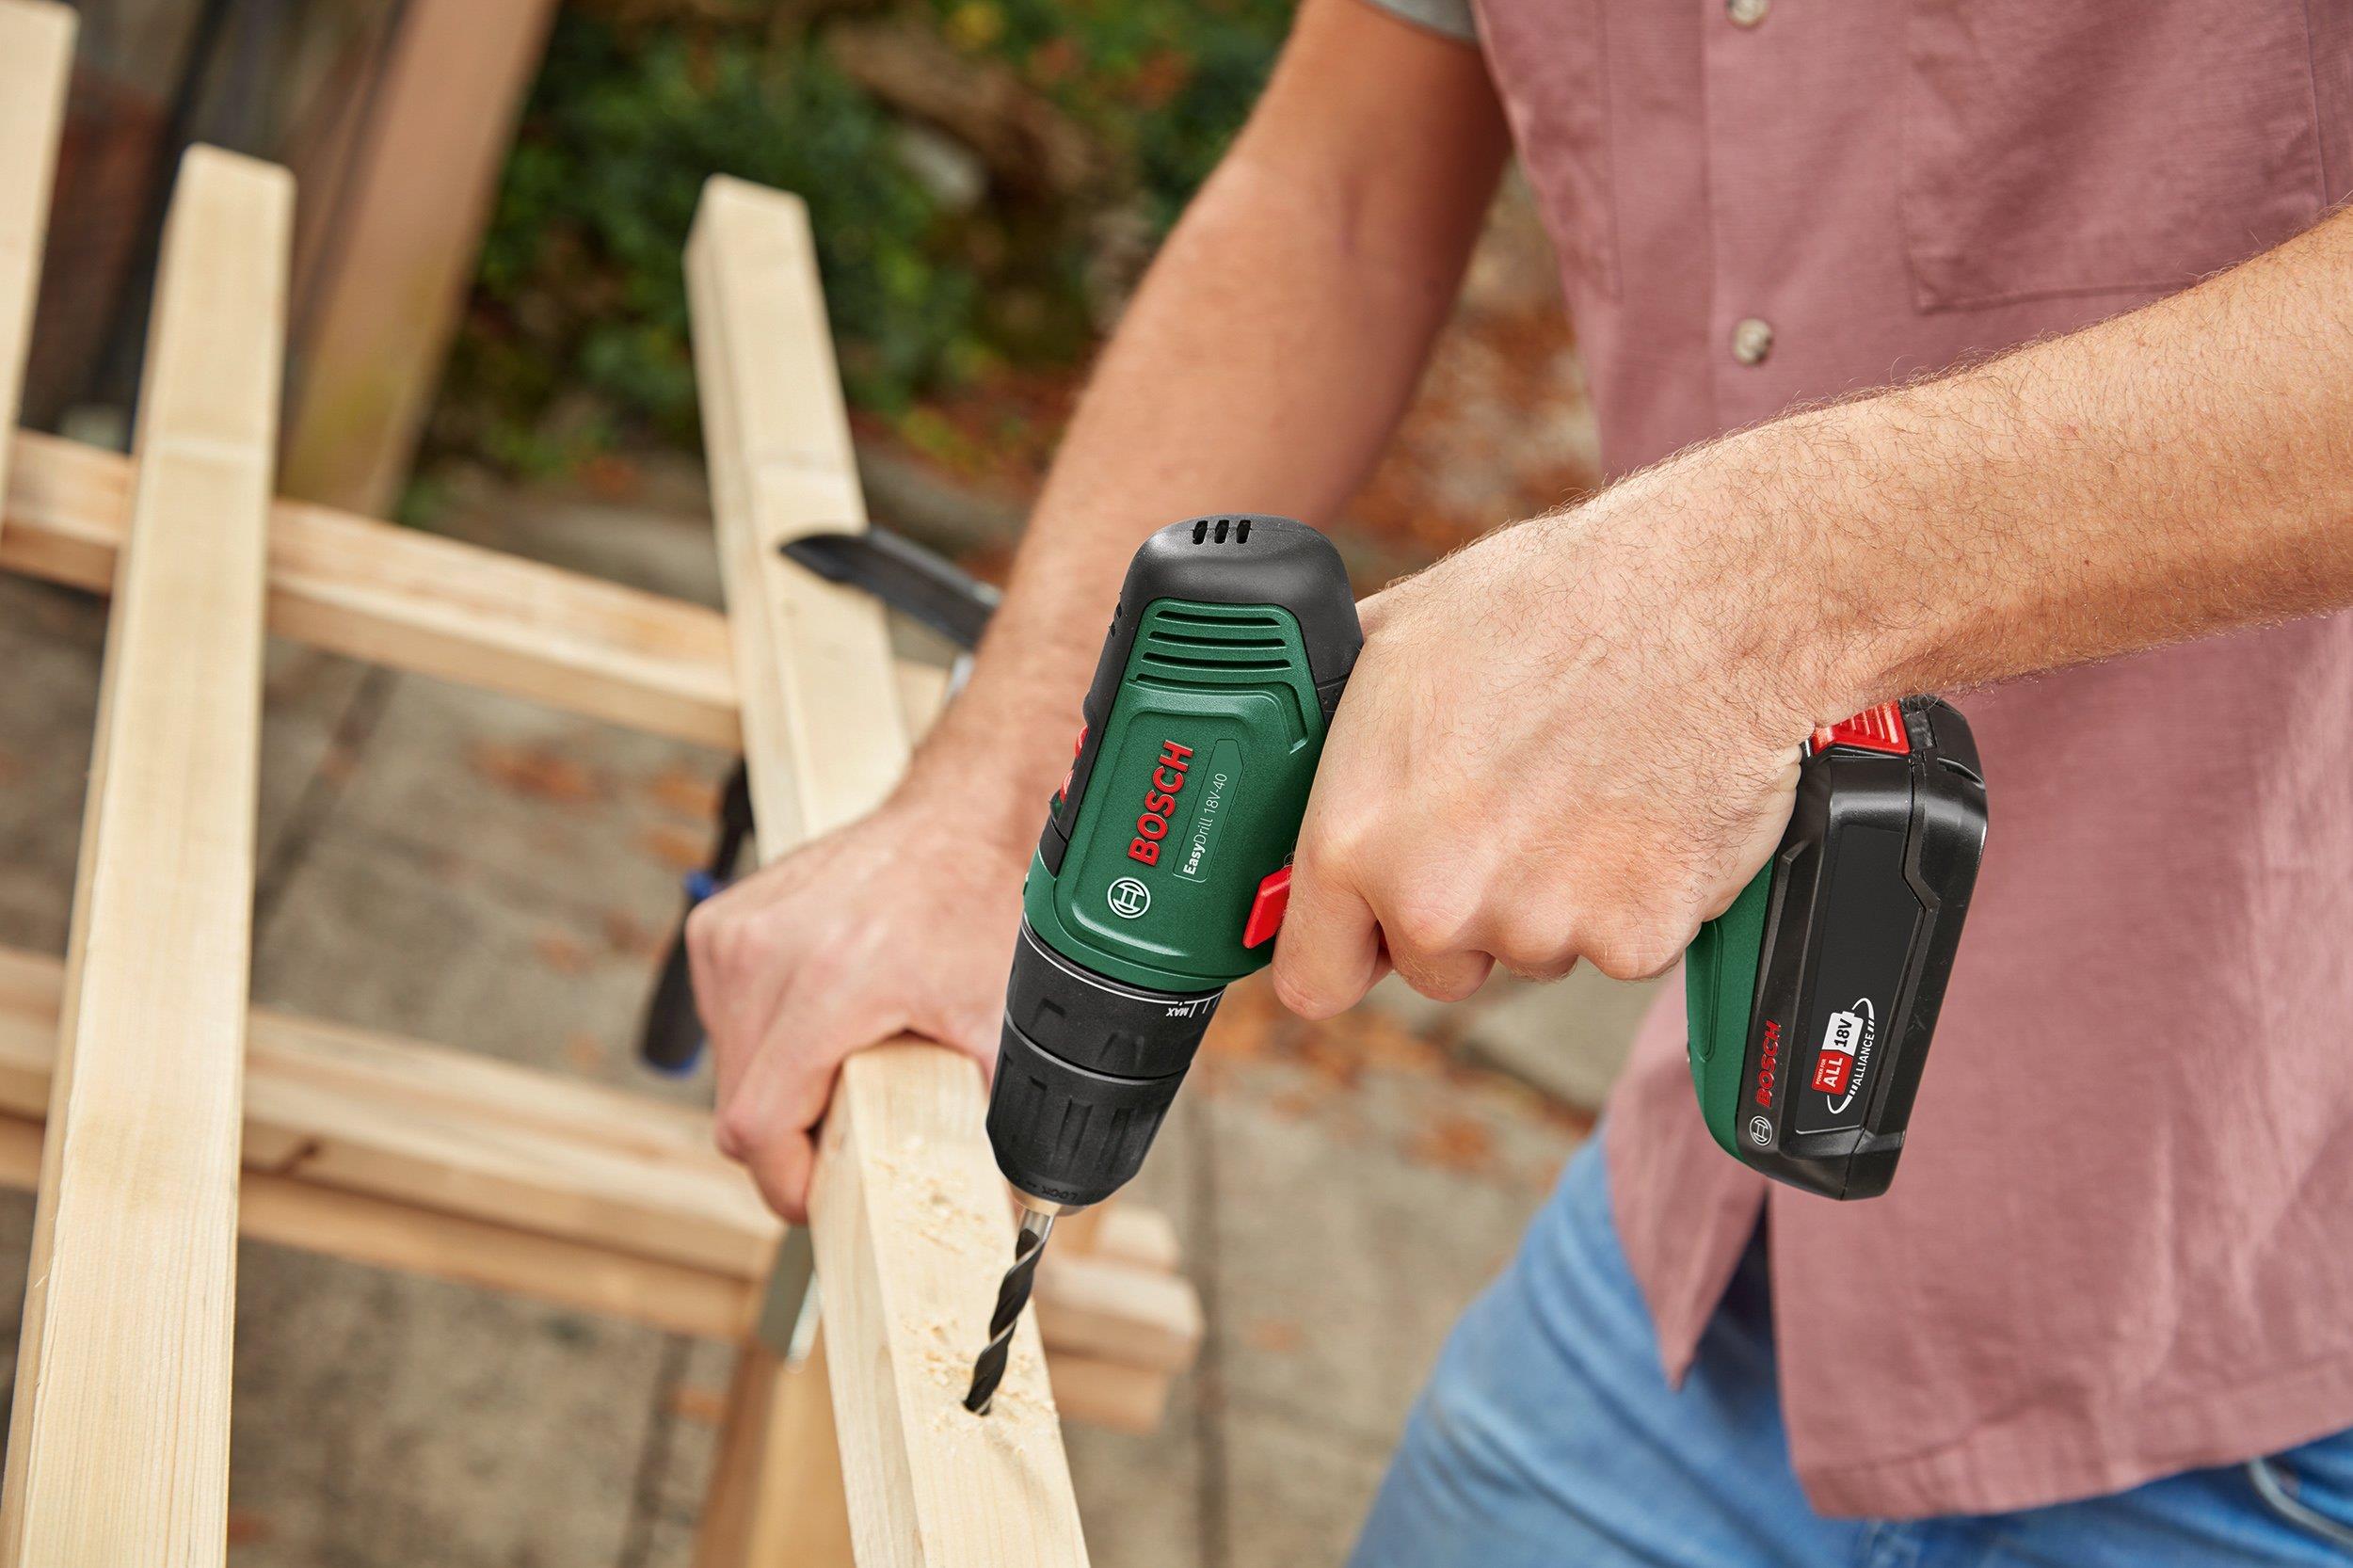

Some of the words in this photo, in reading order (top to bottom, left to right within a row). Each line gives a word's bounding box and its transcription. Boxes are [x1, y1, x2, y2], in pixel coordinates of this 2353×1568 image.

[1128, 740, 1193, 866] BOSCH
[1183, 817, 1213, 875] EasyDrill
[1204, 773, 1227, 814] 18V-40
[1166, 1007, 1190, 1017] MAX
[1756, 1019, 1781, 1108] BOSCH
[1816, 1070, 1825, 1085] POWER
[1823, 1058, 1843, 1088] ALL
[1834, 1018, 1853, 1048] 18V
[1853, 1032, 1875, 1087] ALLIANCE
